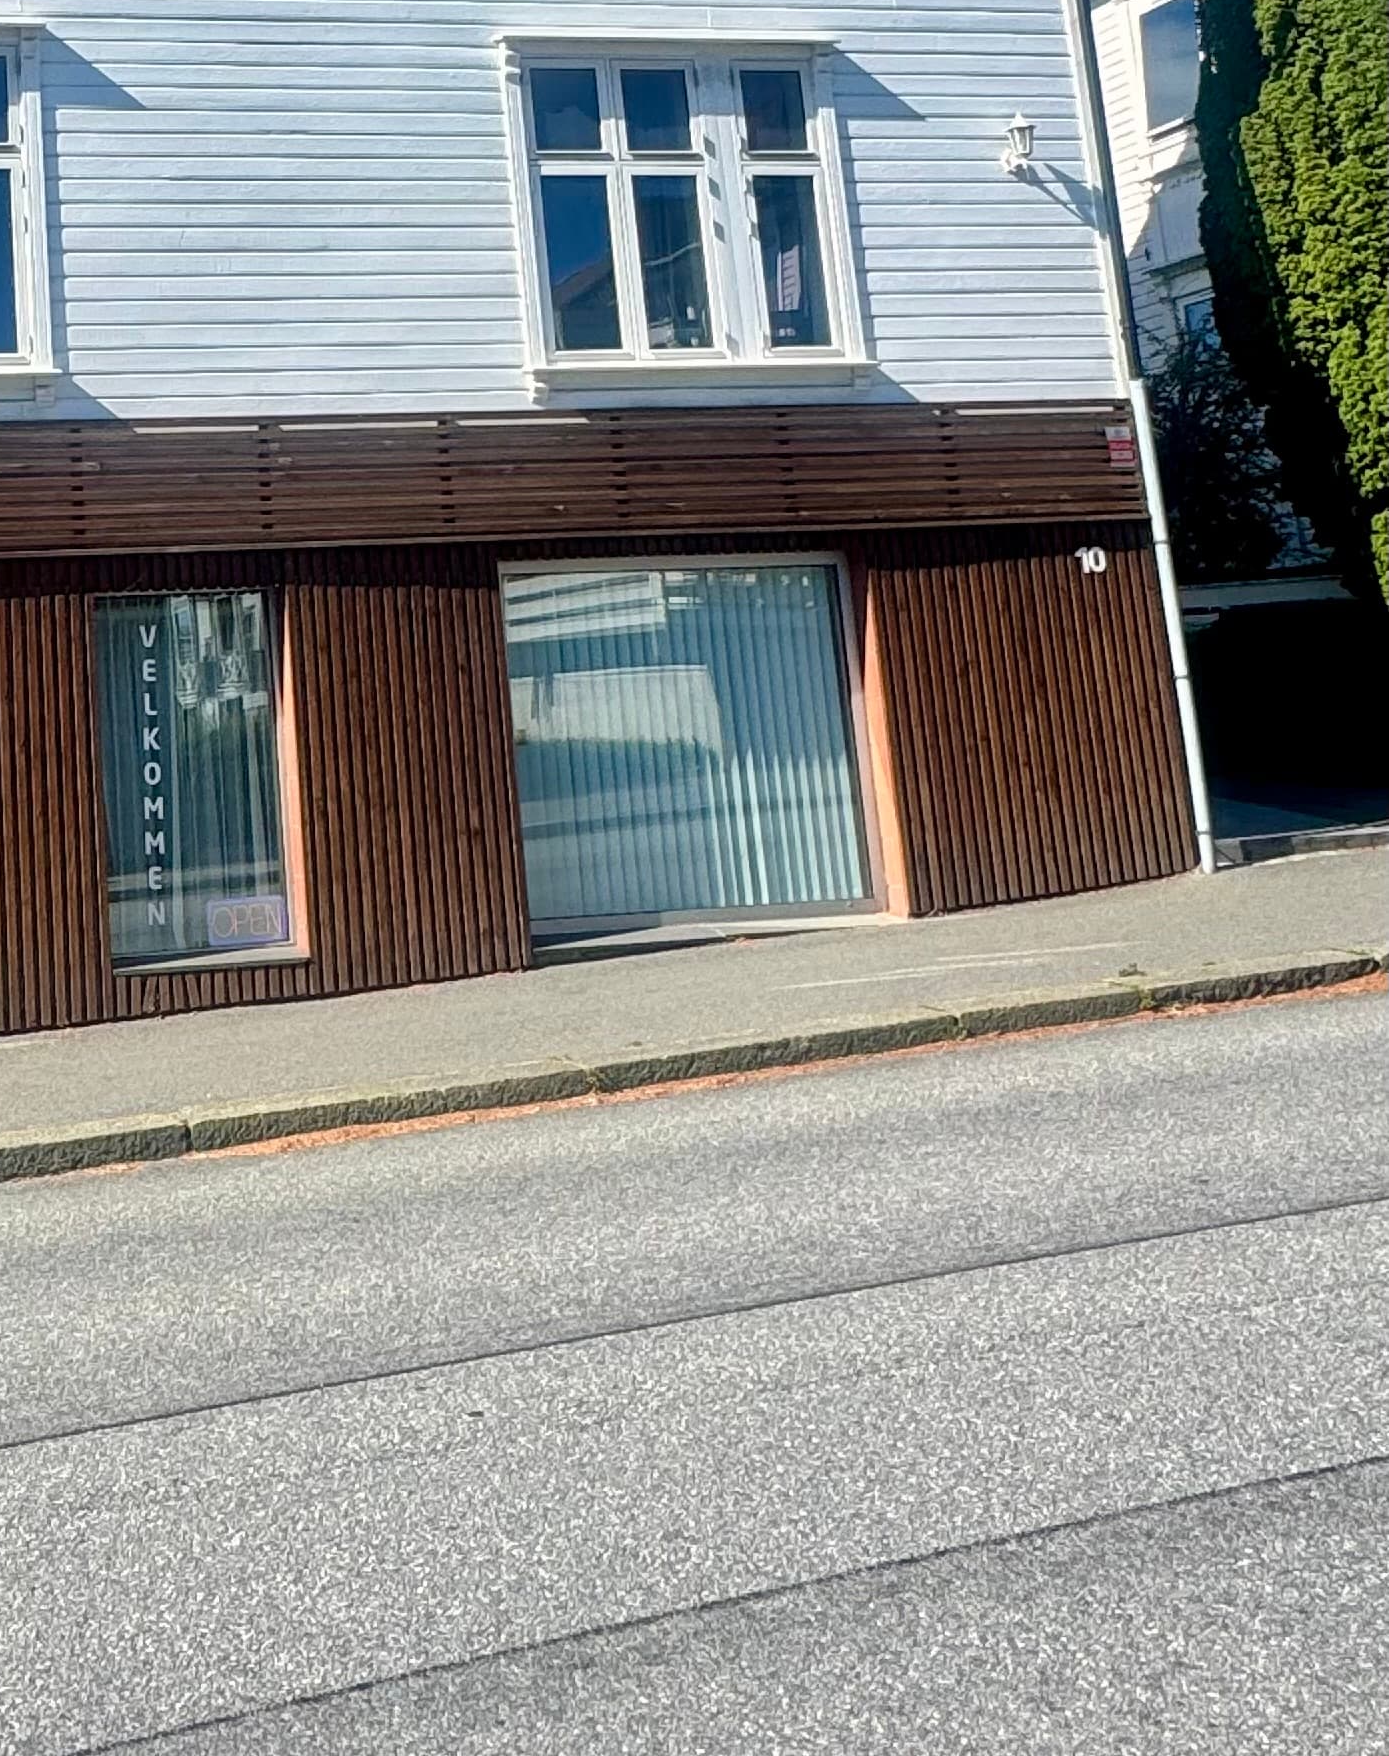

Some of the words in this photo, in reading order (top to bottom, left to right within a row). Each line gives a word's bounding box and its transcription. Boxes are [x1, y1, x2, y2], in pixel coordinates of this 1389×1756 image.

[1075, 547, 1106, 574] 10
[138, 624, 166, 927] VELKOMMEN
[212, 904, 282, 938] OPEN
